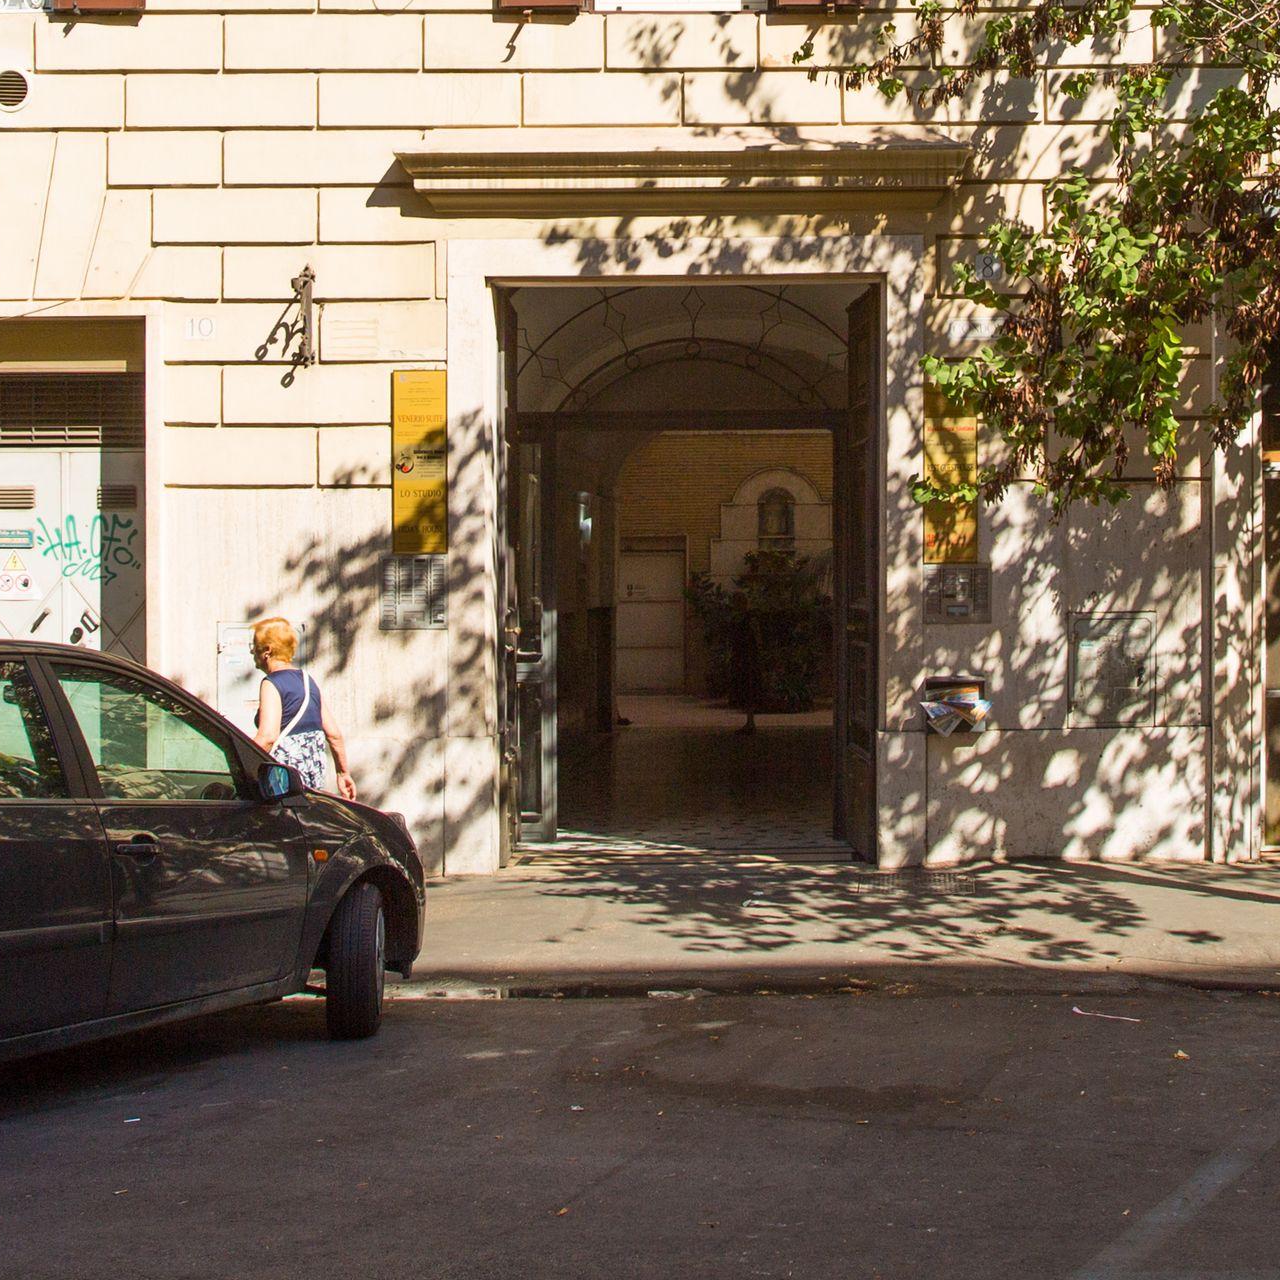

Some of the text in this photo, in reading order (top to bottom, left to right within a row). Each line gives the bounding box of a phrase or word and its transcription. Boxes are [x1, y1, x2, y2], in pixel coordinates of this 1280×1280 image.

[982, 256, 994, 278] 8
[190, 317, 214, 337] 10
[399, 489, 442, 498] LO STUDIO
